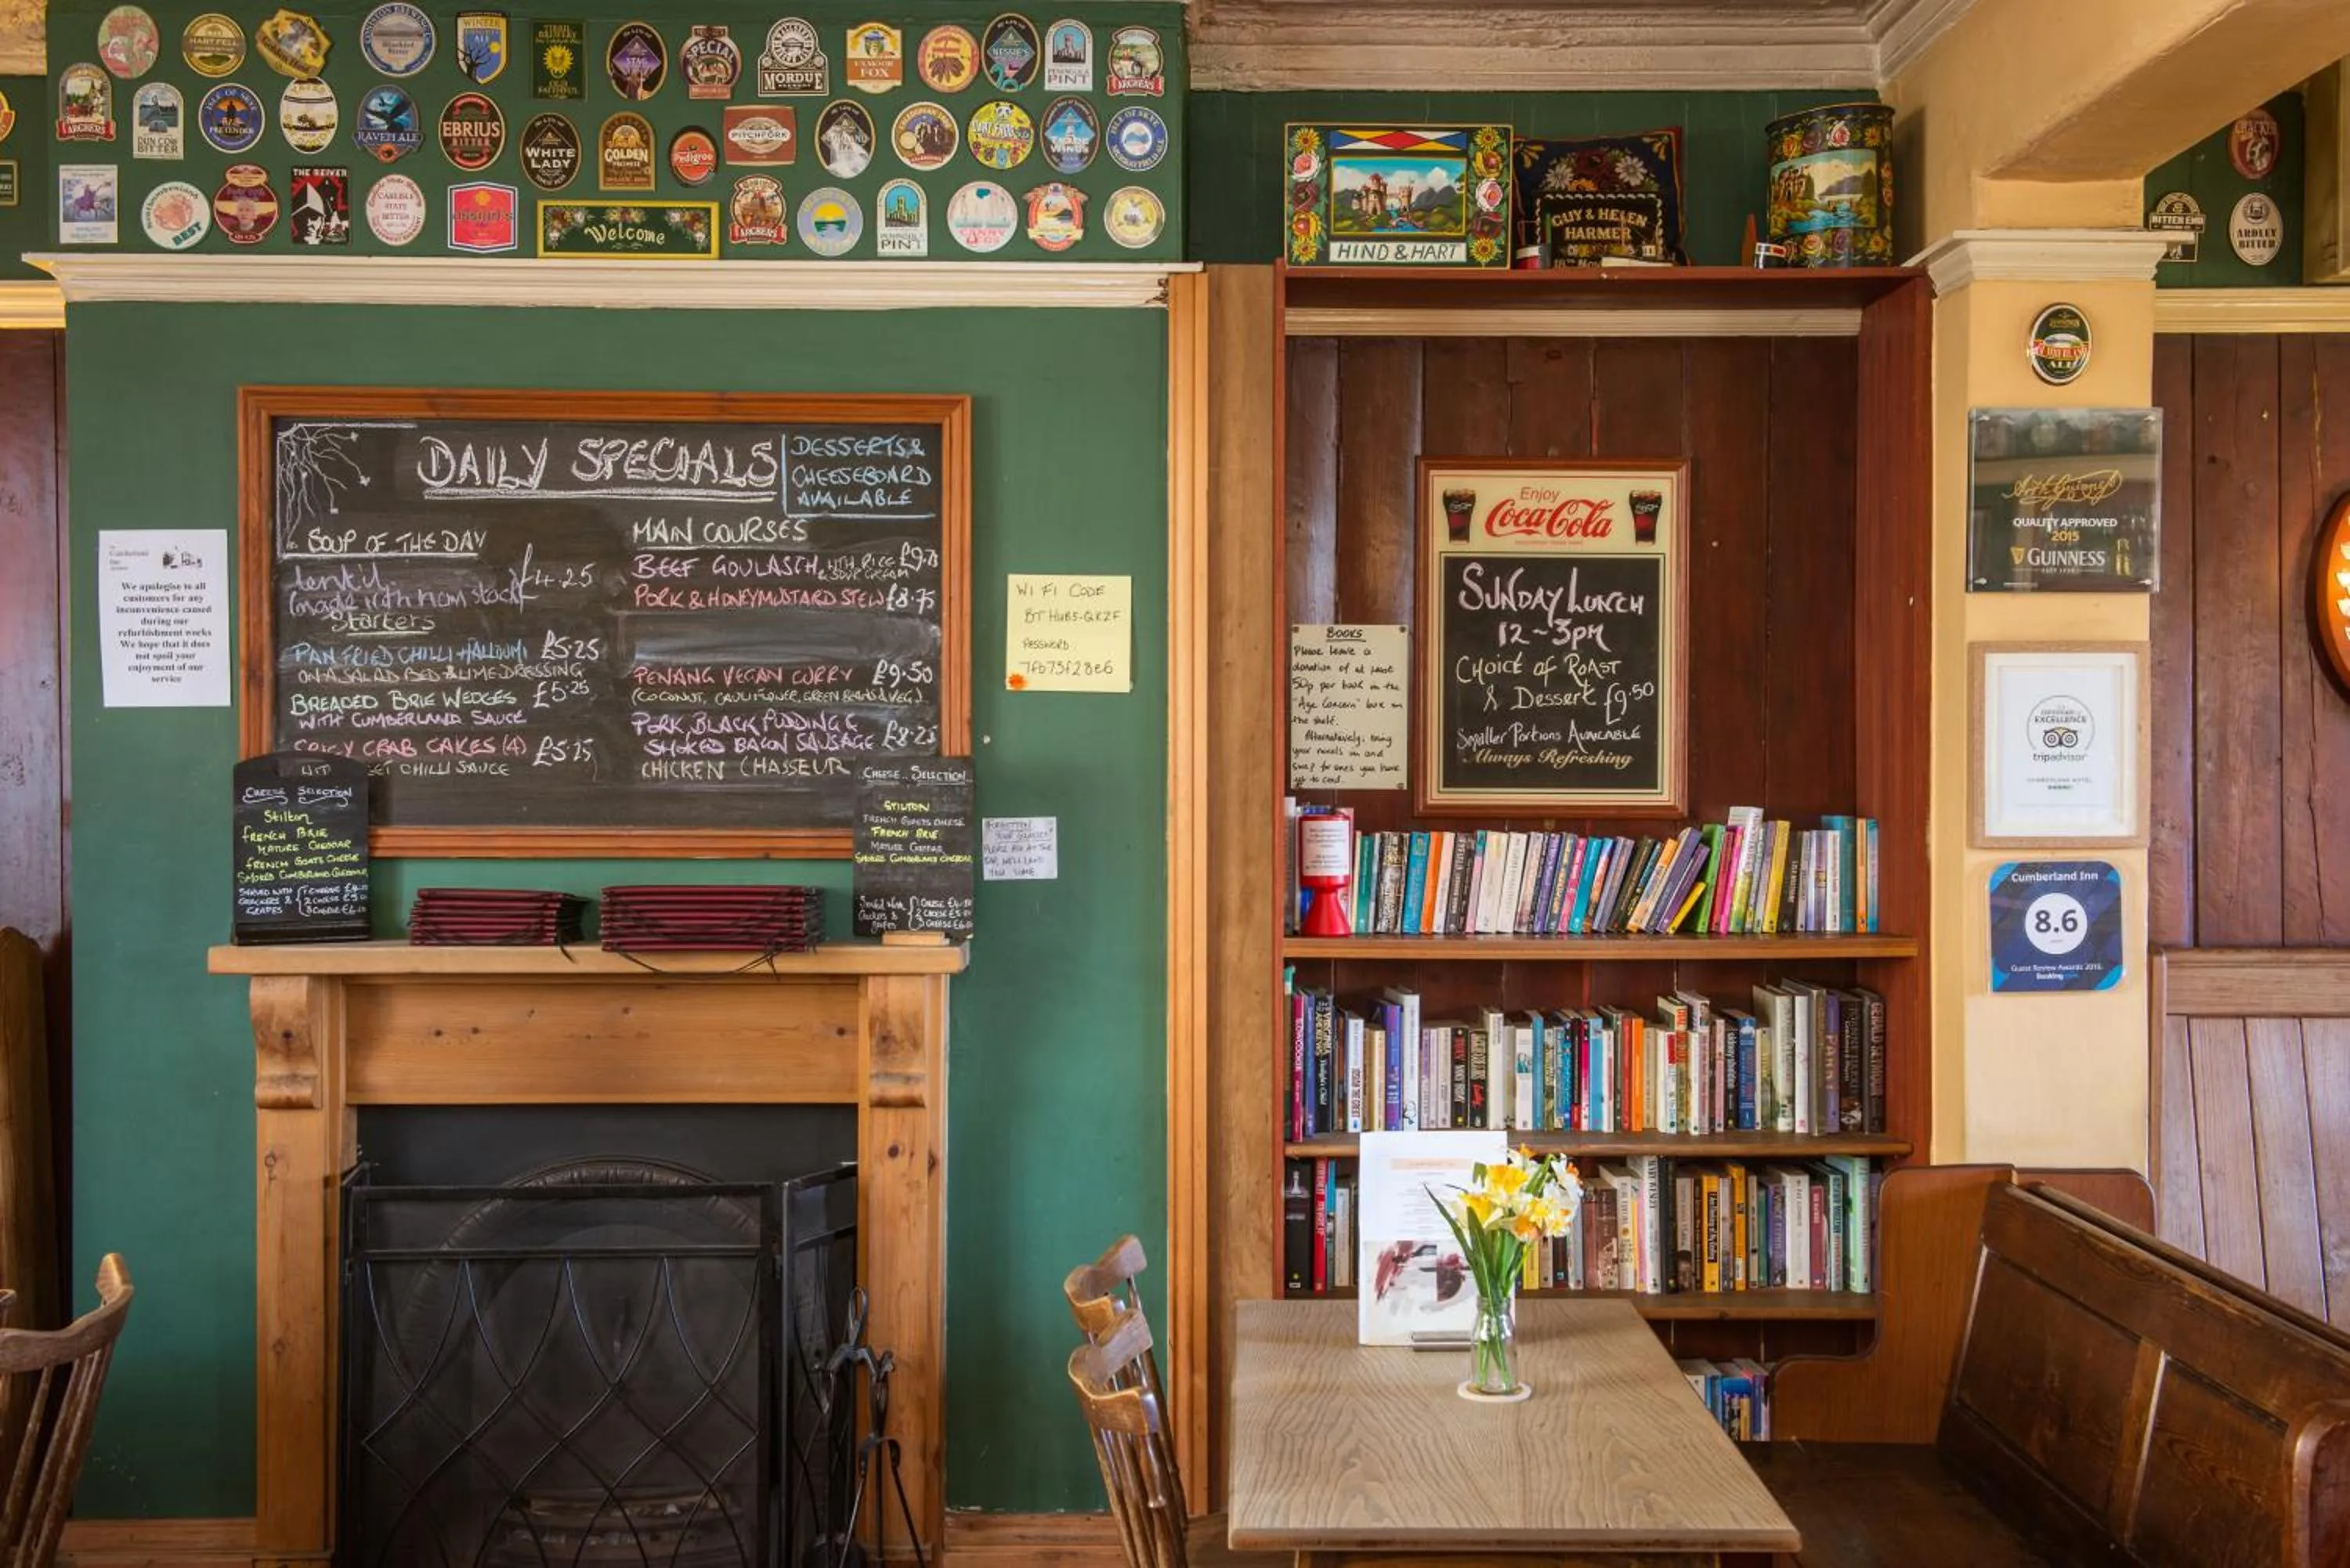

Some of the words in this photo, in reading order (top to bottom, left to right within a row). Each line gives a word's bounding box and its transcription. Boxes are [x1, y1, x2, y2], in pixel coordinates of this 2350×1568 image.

[686, 39, 735, 63] SPECIAL
[764, 72, 822, 90] MORDUE
[861, 68, 889, 78] FOX
[1047, 76, 1086, 85] PINT
[359, 132, 395, 142] RAVEN
[398, 132, 419, 142] ALE
[443, 121, 501, 137] EBRIUS
[730, 129, 788, 139] PITCHFORK
[526, 147, 576, 157] WHITE
[605, 147, 649, 163] GOLDEN
[293, 168, 311, 177] THE
[531, 159, 571, 168] LADY
[1551, 208, 1583, 227] GUY
[1598, 208, 1648, 227] HELEN
[584, 221, 665, 244] Welcome
[1564, 226, 1632, 240] HARMER
[880, 239, 922, 250] PINT
[1337, 243, 1390, 261] HIND
[1394, 243, 1408, 261] &
[1410, 243, 1460, 260] HART
[418, 435, 548, 491] DAILY
[571, 435, 779, 488] SPECIALS
[797, 489, 913, 506] AVAILABLE
[1520, 486, 1561, 505] Enjoy
[703, 515, 808, 544] COURSES
[2012, 517, 2060, 529] QUALITY
[2061, 517, 2118, 529] APPROVED
[307, 527, 356, 553] SOUP
[365, 533, 389, 553] OF
[396, 532, 436, 553] THE
[442, 529, 488, 553] DAY
[2051, 530, 2080, 542] 2015
[631, 553, 701, 580] BEEF
[2027, 547, 2106, 568] GUINNESS
[634, 583, 685, 609] PORK
[1458, 562, 1564, 629] SUNDAY
[1567, 565, 1645, 616] LUNCH
[331, 610, 436, 632] Starters
[1325, 626, 1366, 639] BOOKS
[540, 629, 600, 661] £5.25
[632, 666, 716, 687] PENANG
[722, 666, 784, 688] VEGAN
[791, 665, 854, 686] CURRY
[871, 659, 934, 688] £9.50
[1455, 651, 1524, 684] CHOICE
[1563, 652, 1624, 688] ROAST
[290, 692, 379, 716] BREADED
[388, 689, 437, 710] BRIE
[442, 685, 518, 709] WEDGES
[532, 679, 590, 709] £5.25
[1509, 678, 1598, 711] Dessert
[1603, 682, 1655, 726] £9.50
[298, 714, 345, 730] WITH
[352, 711, 462, 728] CUMBERLAND
[470, 710, 527, 726] SAUCE
[689, 710, 761, 736] BLACK
[761, 707, 841, 733] PUDDING
[2034, 715, 2088, 724] EXCELLENCE
[426, 733, 497, 757] CAKES
[733, 731, 788, 754] BACON
[796, 731, 876, 754] SAUSAGE
[1462, 748, 1533, 770] Always
[1537, 747, 1635, 771] Refreshing
[2032, 751, 2085, 764] tripadvisor
[455, 759, 510, 776] SAUCE
[642, 758, 725, 781] CHICKEN
[739, 754, 851, 777] CHASSEUR
[263, 810, 313, 825] Stilton
[2011, 871, 2077, 883] Cumberland
[2080, 870, 2099, 881] Inn
[2034, 909, 2079, 934] 8.6
